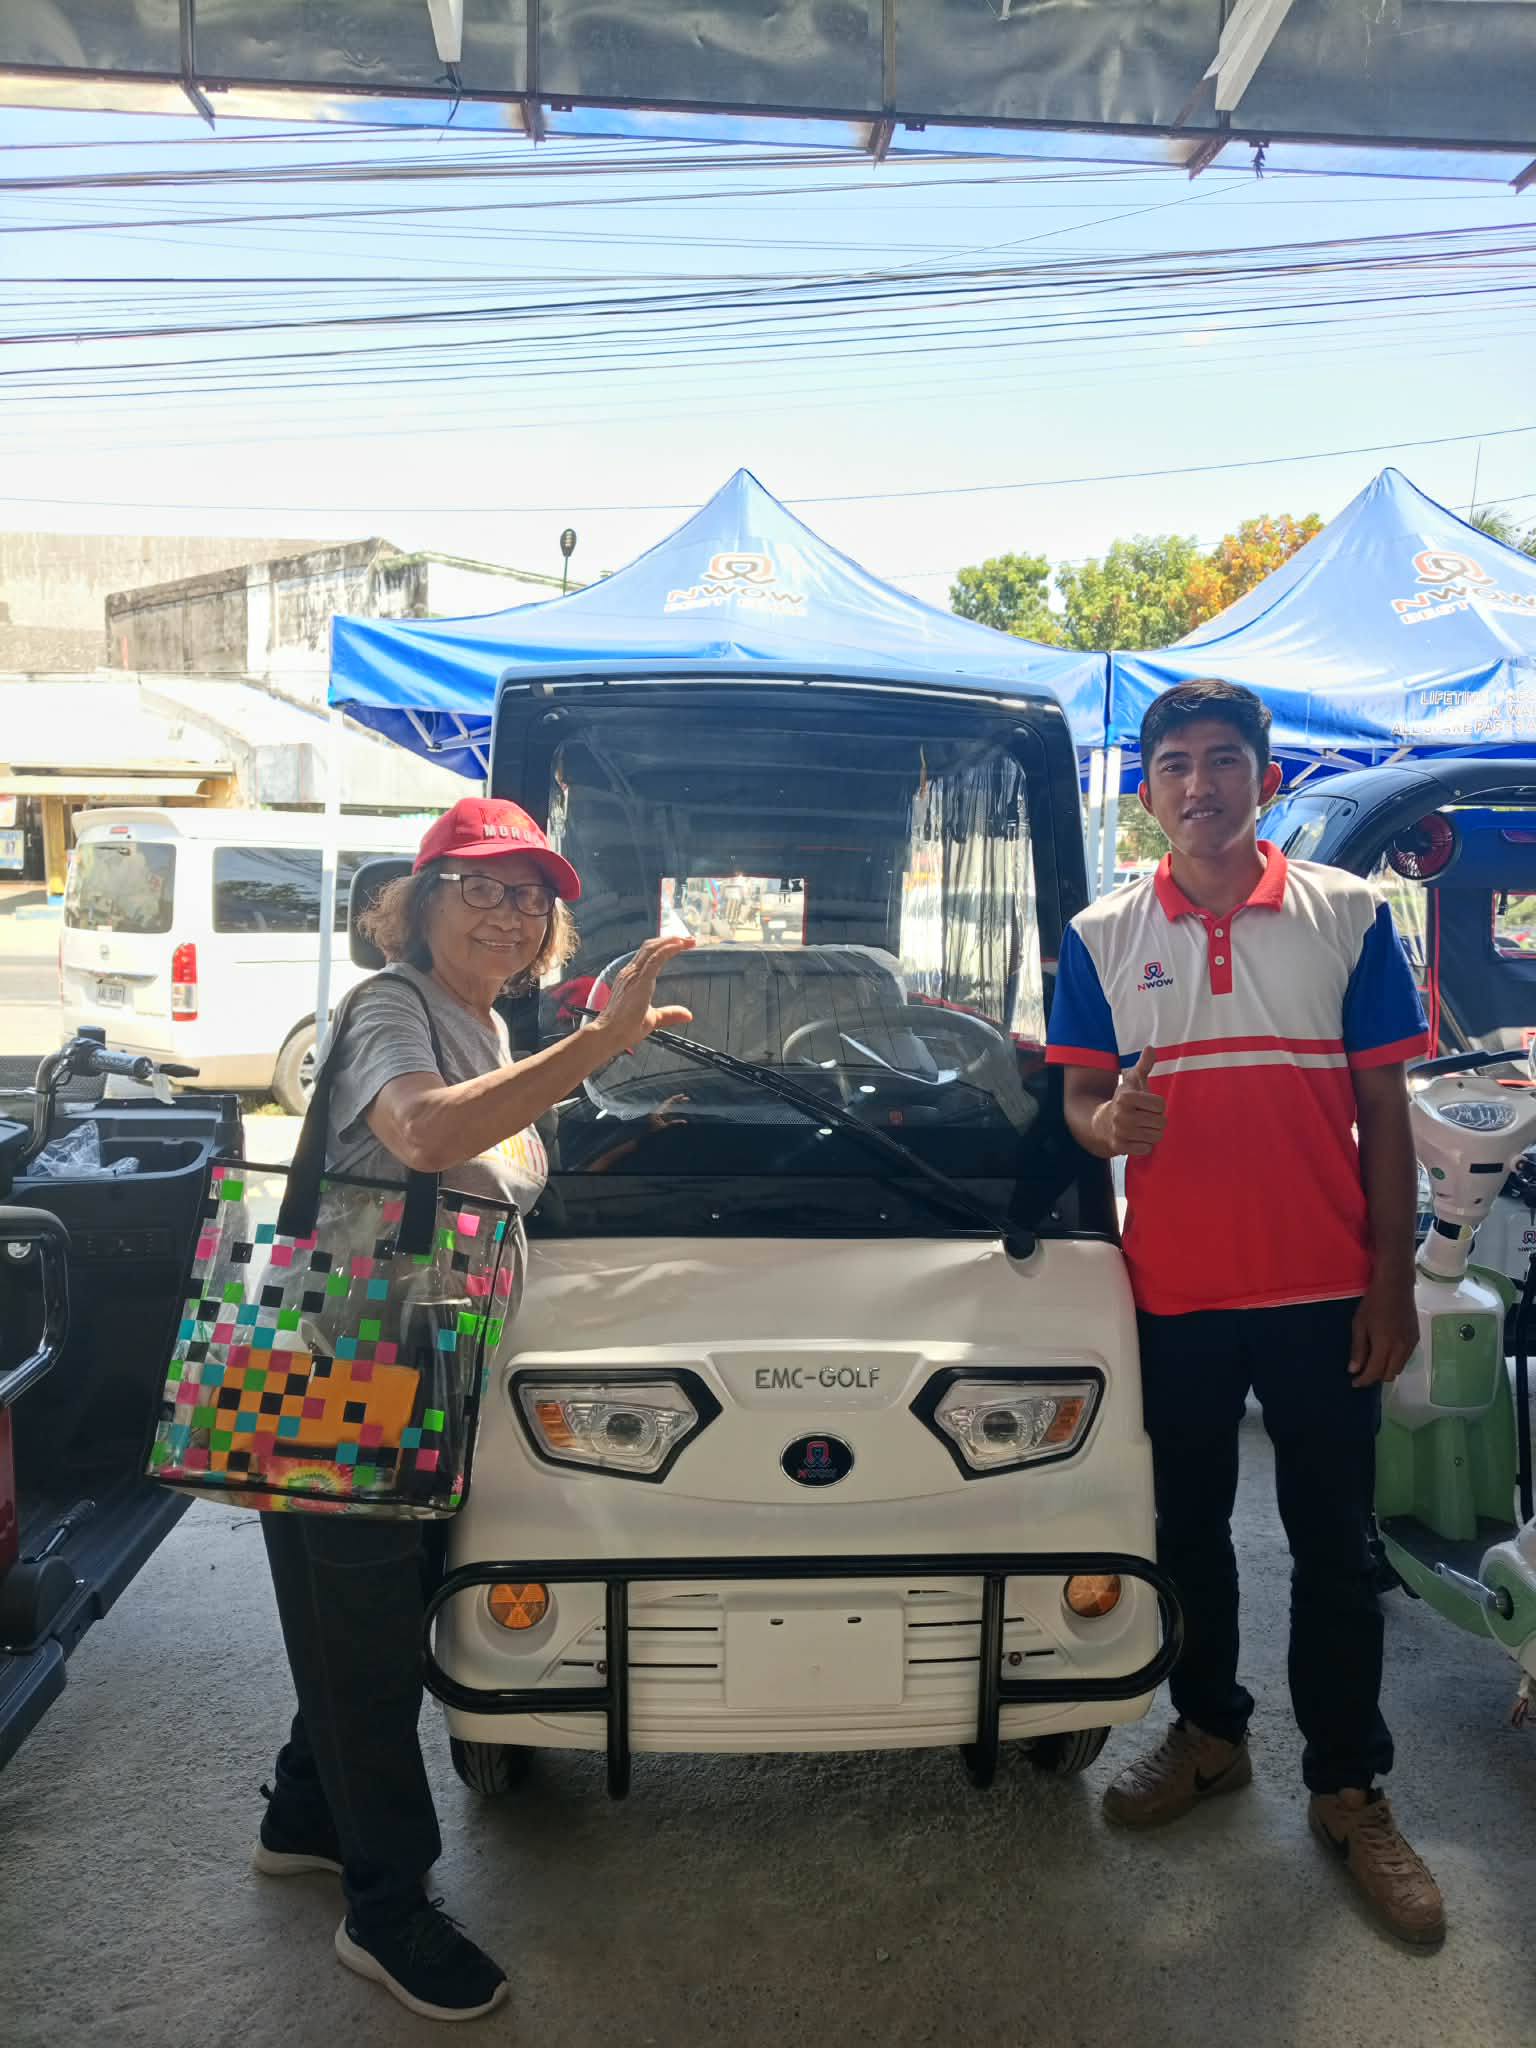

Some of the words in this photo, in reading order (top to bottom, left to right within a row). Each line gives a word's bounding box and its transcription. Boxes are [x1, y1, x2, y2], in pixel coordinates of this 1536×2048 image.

[667, 585, 806, 604] NWOW
[1137, 977, 1174, 992] NWOW
[755, 1367, 880, 1388] EMC-GOLF
